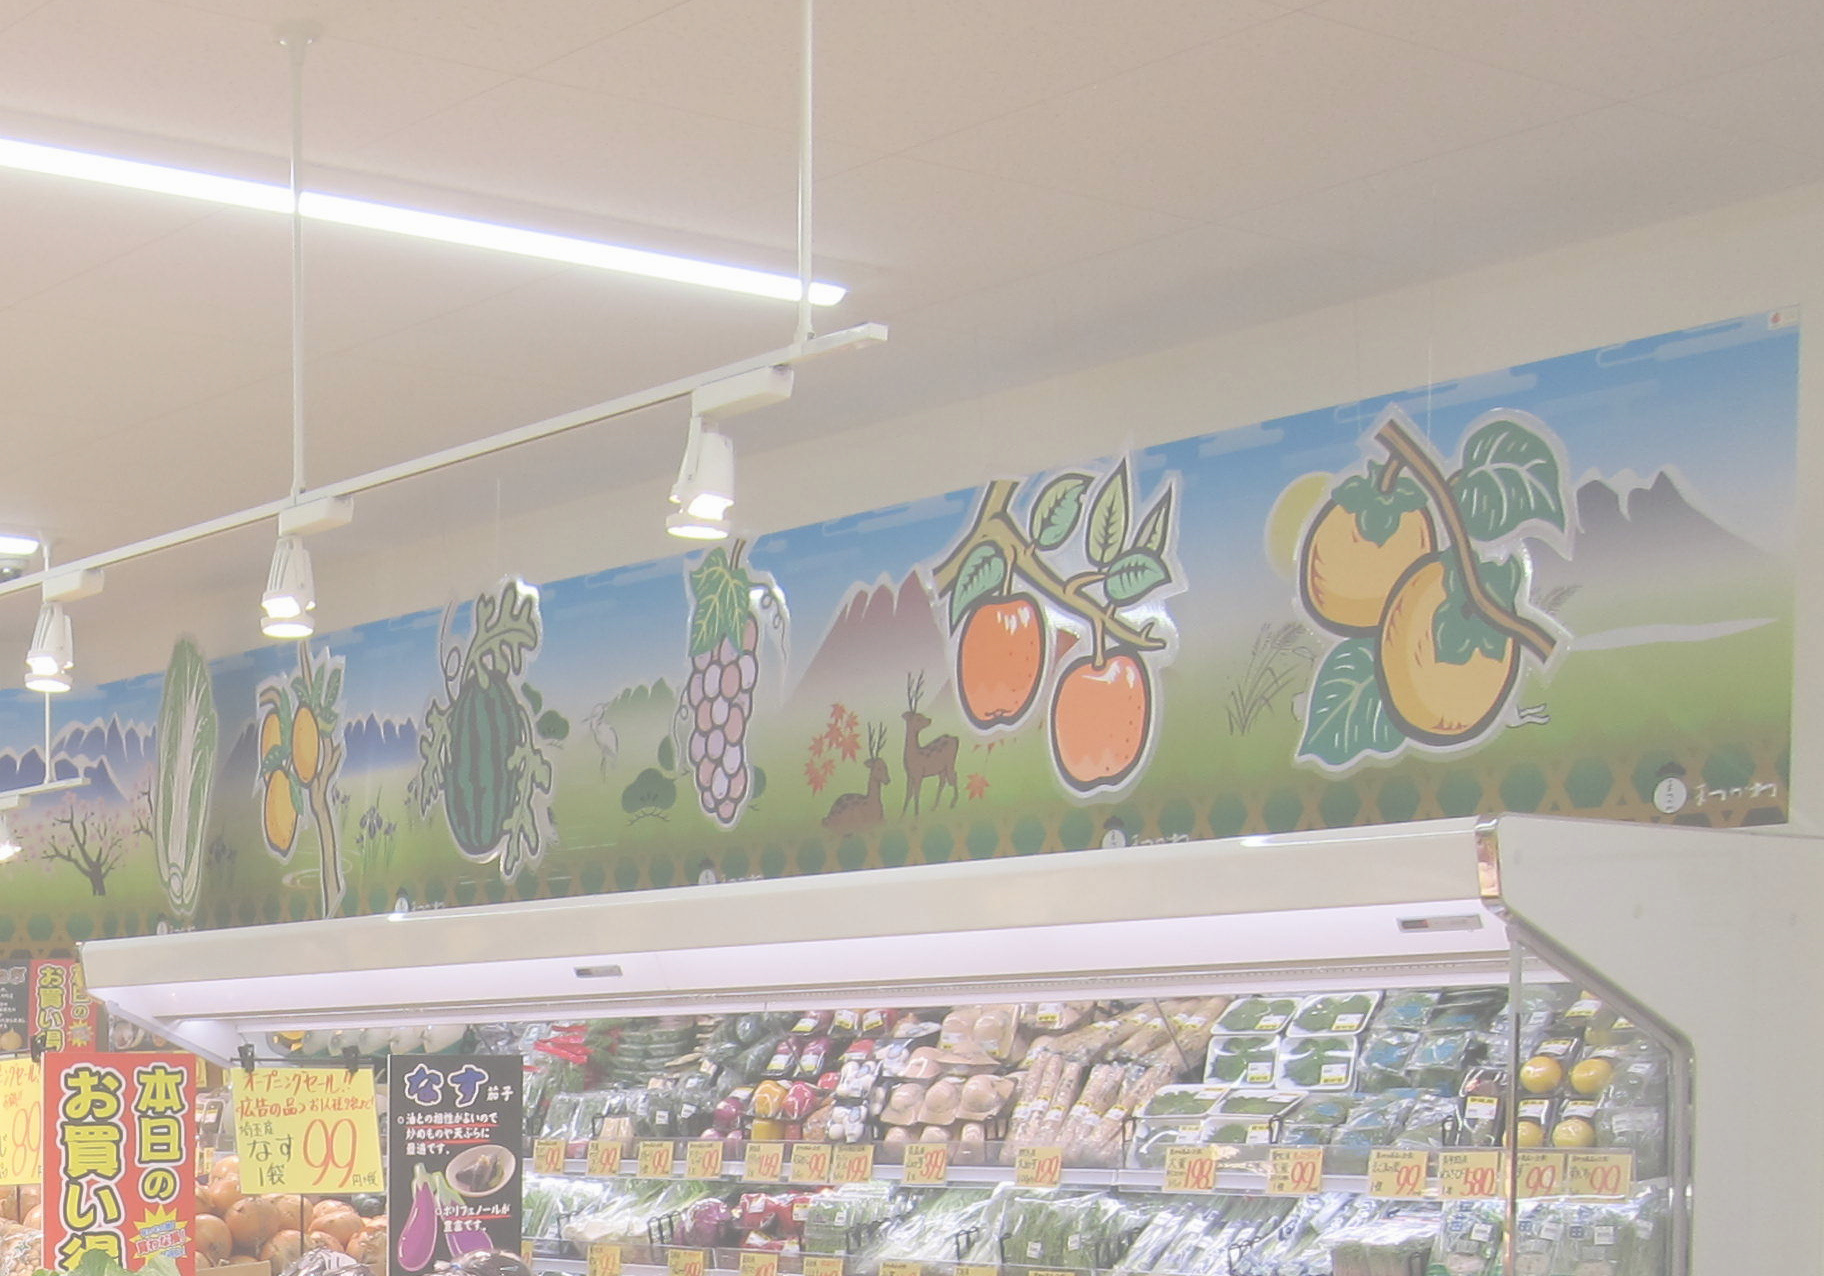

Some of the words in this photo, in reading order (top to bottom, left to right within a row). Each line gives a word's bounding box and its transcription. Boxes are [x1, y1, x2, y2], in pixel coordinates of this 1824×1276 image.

[404, 1062, 489, 1108] なす
[132, 1065, 190, 1203] 本日の
[247, 1134, 295, 1163] なす
[302, 1118, 359, 1188] 99
[257, 1163, 286, 1188] 1袋
[1291, 1161, 1316, 1191] 99
[1395, 1165, 1421, 1195] 99
[1461, 1167, 1495, 1196] 580
[1526, 1165, 1556, 1197] 99
[1590, 1165, 1621, 1196] 99
